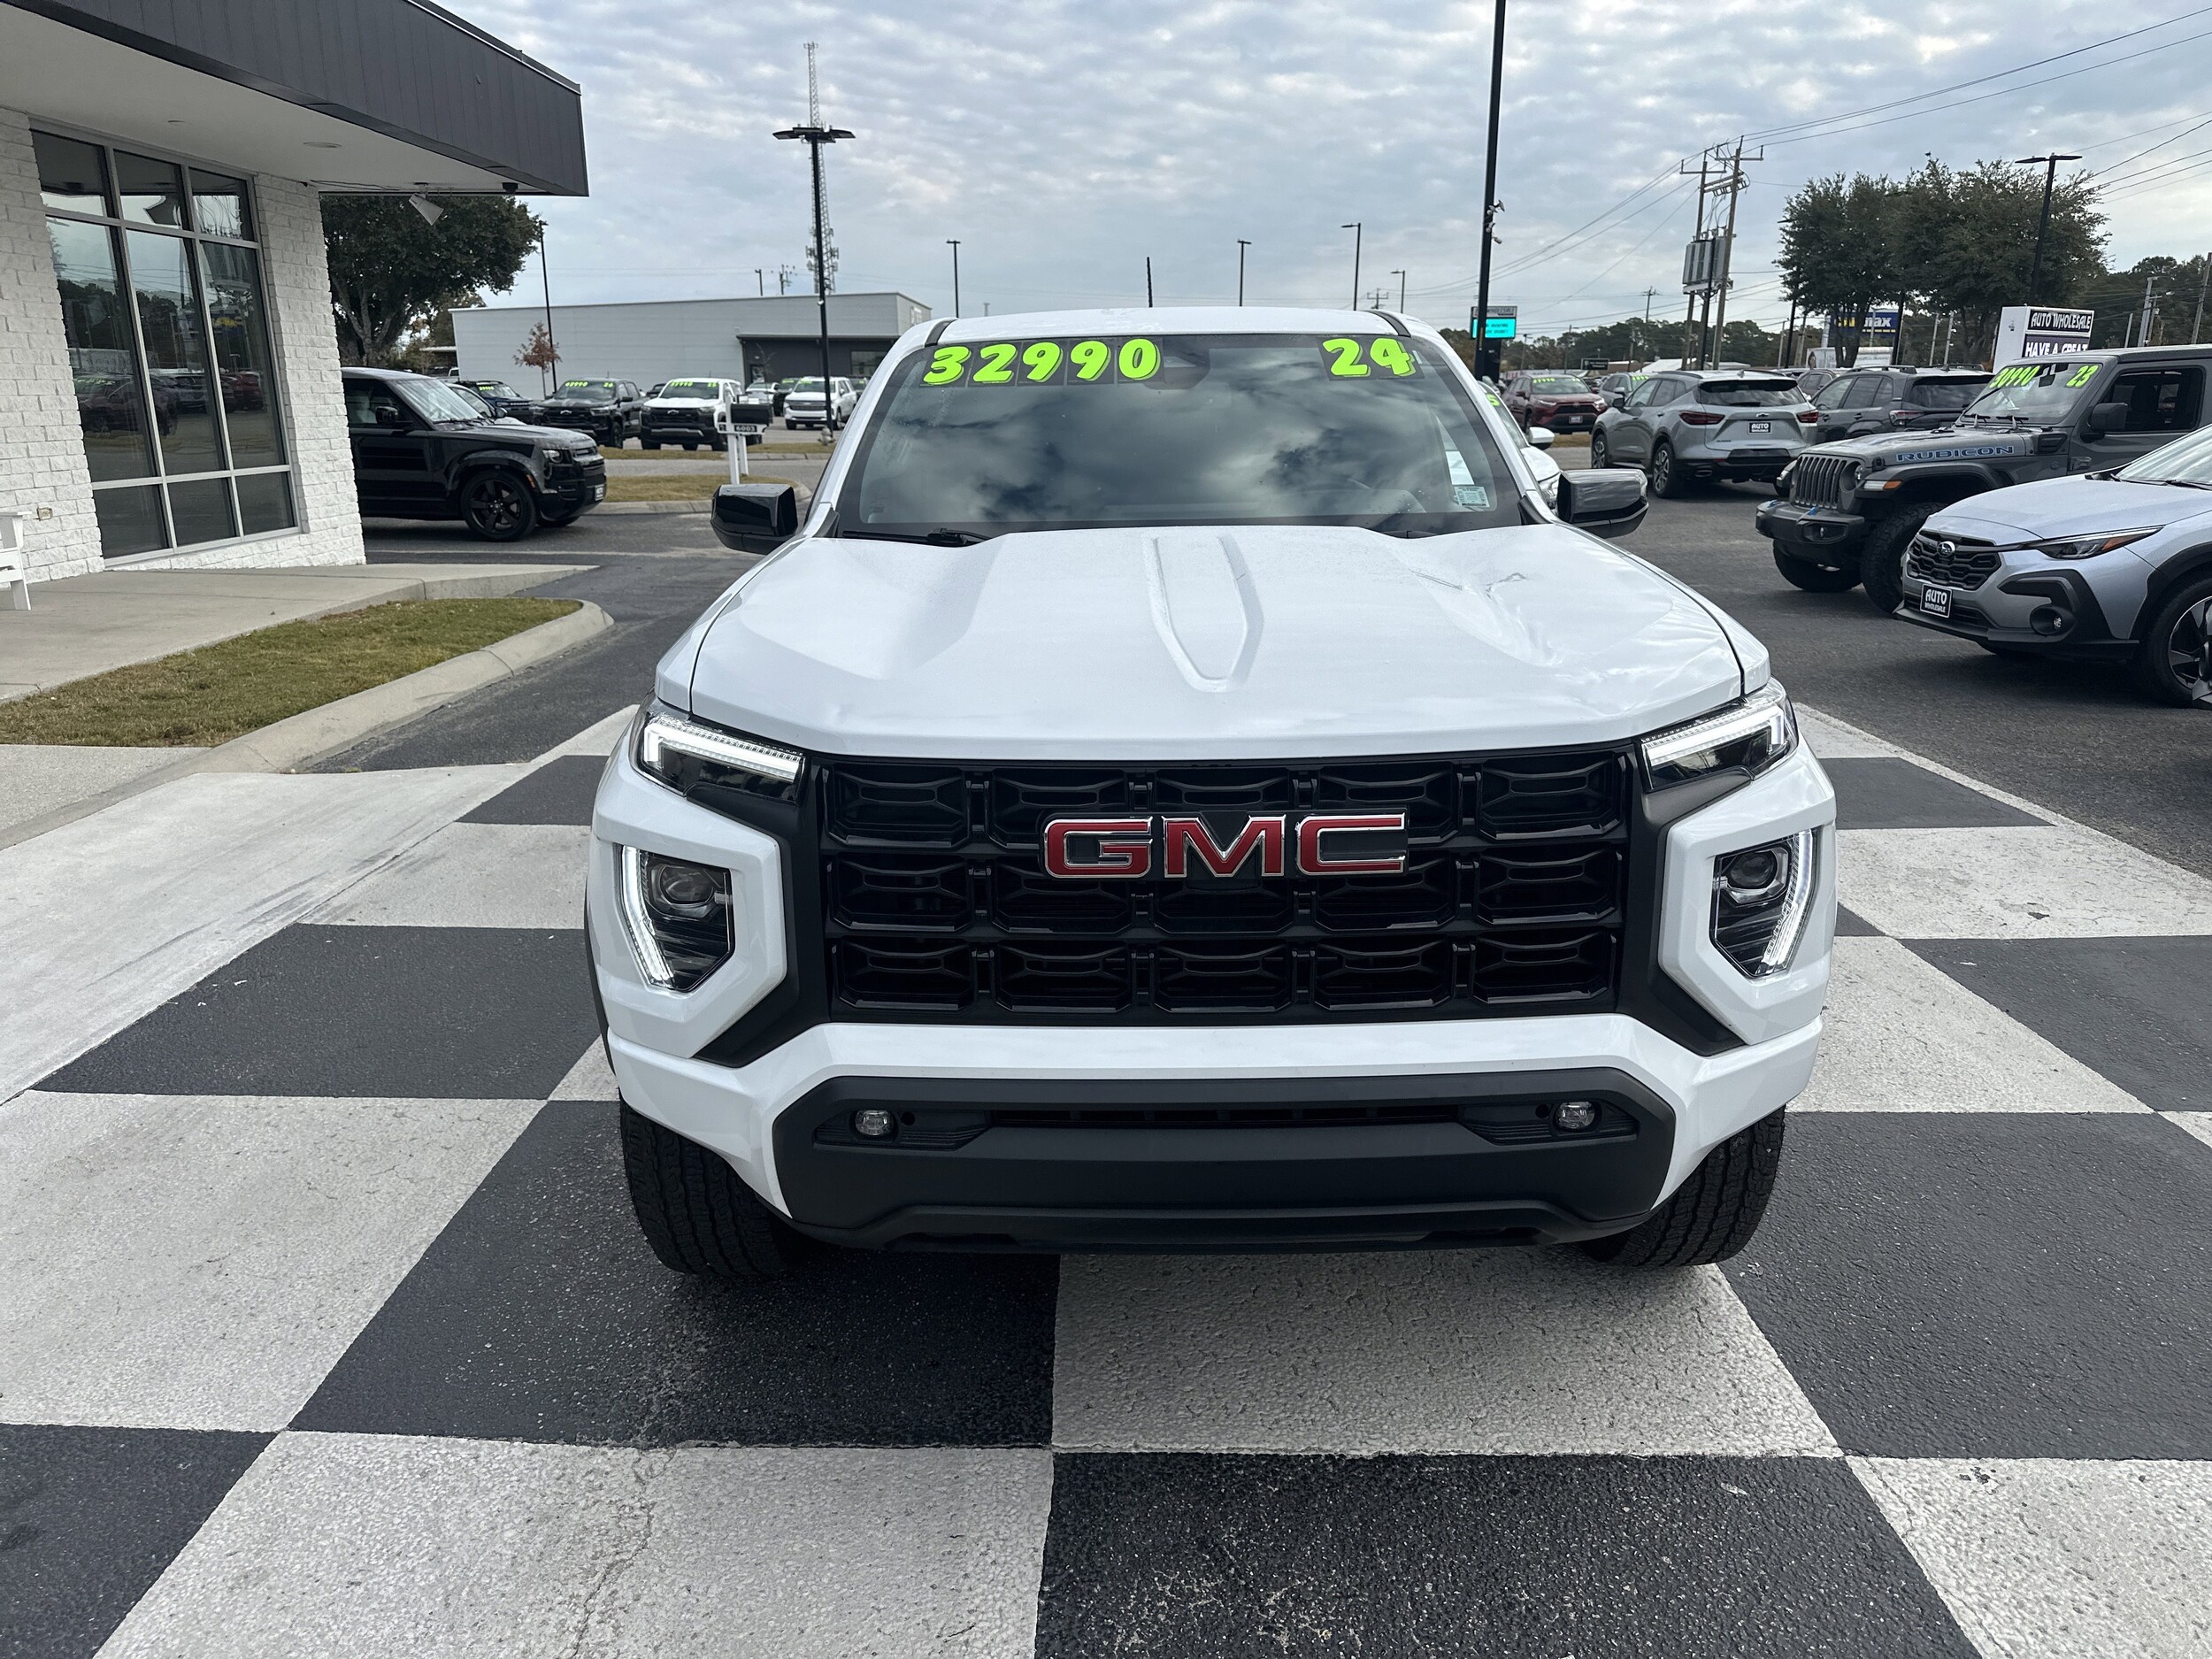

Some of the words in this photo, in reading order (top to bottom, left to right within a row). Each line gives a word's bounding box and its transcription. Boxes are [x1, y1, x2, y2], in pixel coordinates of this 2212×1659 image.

[2031, 311, 2052, 327] AUTO
[2053, 313, 2092, 329] WHOLESALE
[2024, 342, 2051, 357] HAVE
[2052, 342, 2058, 355] A
[923, 338, 1161, 386] 32990
[1322, 337, 1417, 378] 24
[1989, 365, 2040, 388] 30990
[2066, 365, 2100, 388] 23
[1896, 445, 2015, 462] RUBICON
[1925, 588, 1947, 604] AUTO
[1043, 811, 1406, 879] GMC
